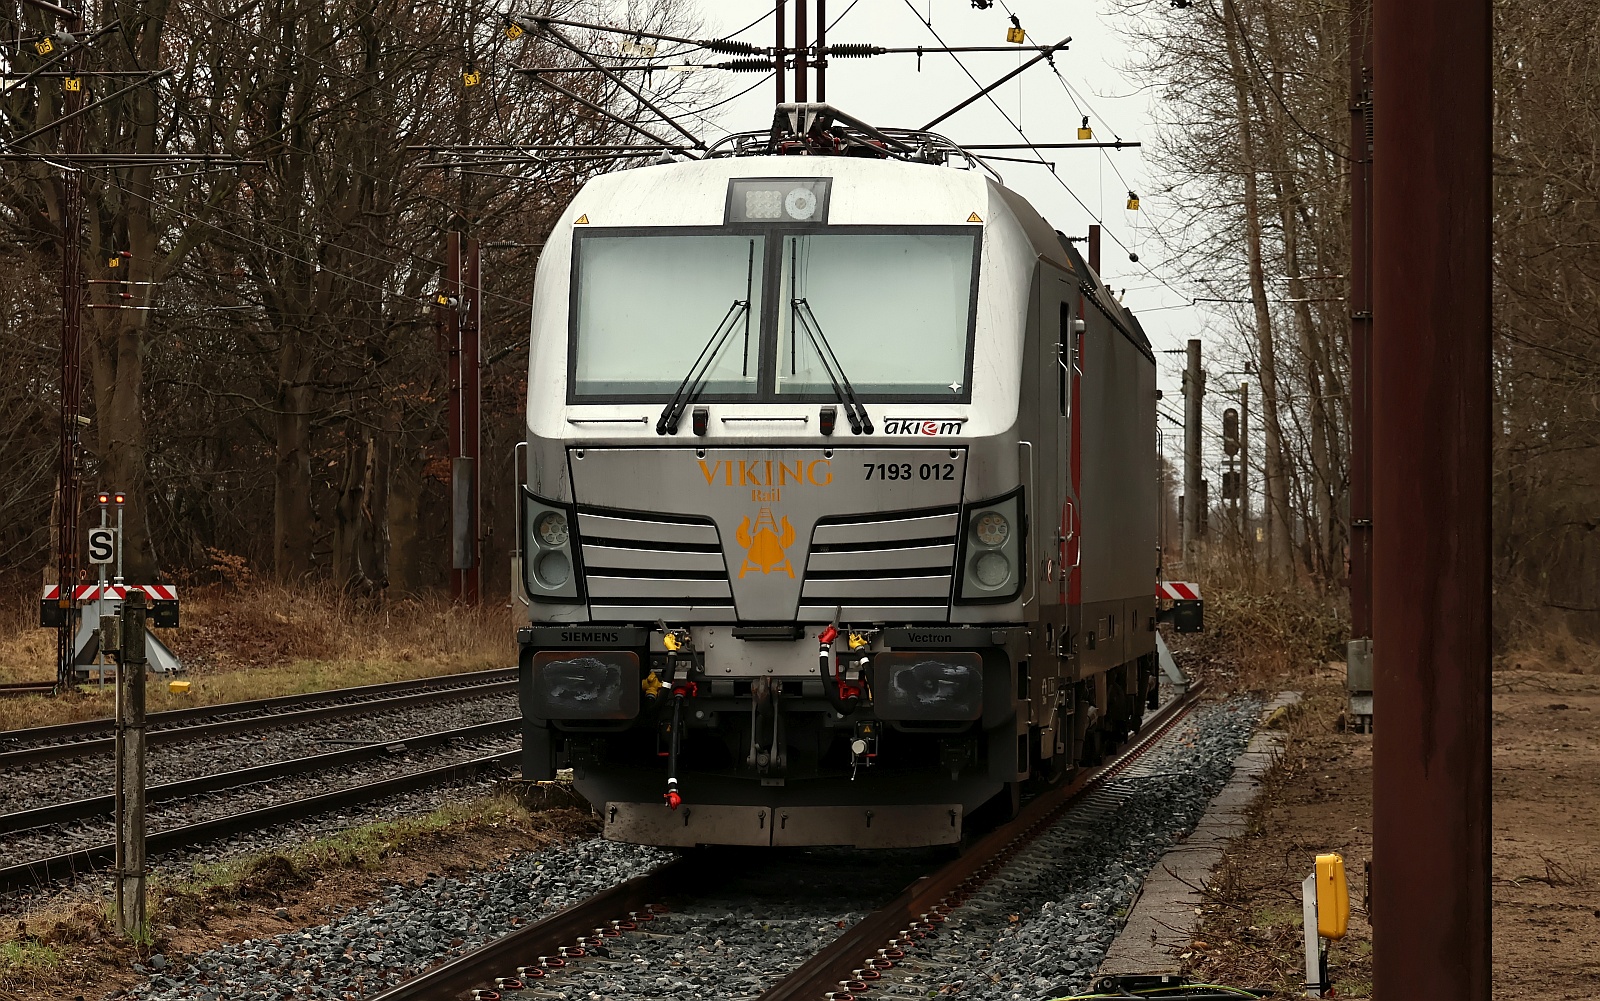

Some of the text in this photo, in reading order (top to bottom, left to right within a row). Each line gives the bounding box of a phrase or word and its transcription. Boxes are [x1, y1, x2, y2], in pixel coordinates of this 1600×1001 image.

[66, 80, 78, 90] S4
[885, 419, 962, 435] akiem
[697, 460, 834, 486] VIKING
[863, 464, 954, 481] 7193 012
[751, 489, 780, 502] Rail
[89, 532, 113, 560] S
[561, 632, 618, 642] SIEMENS
[908, 633, 952, 643] Vectron
